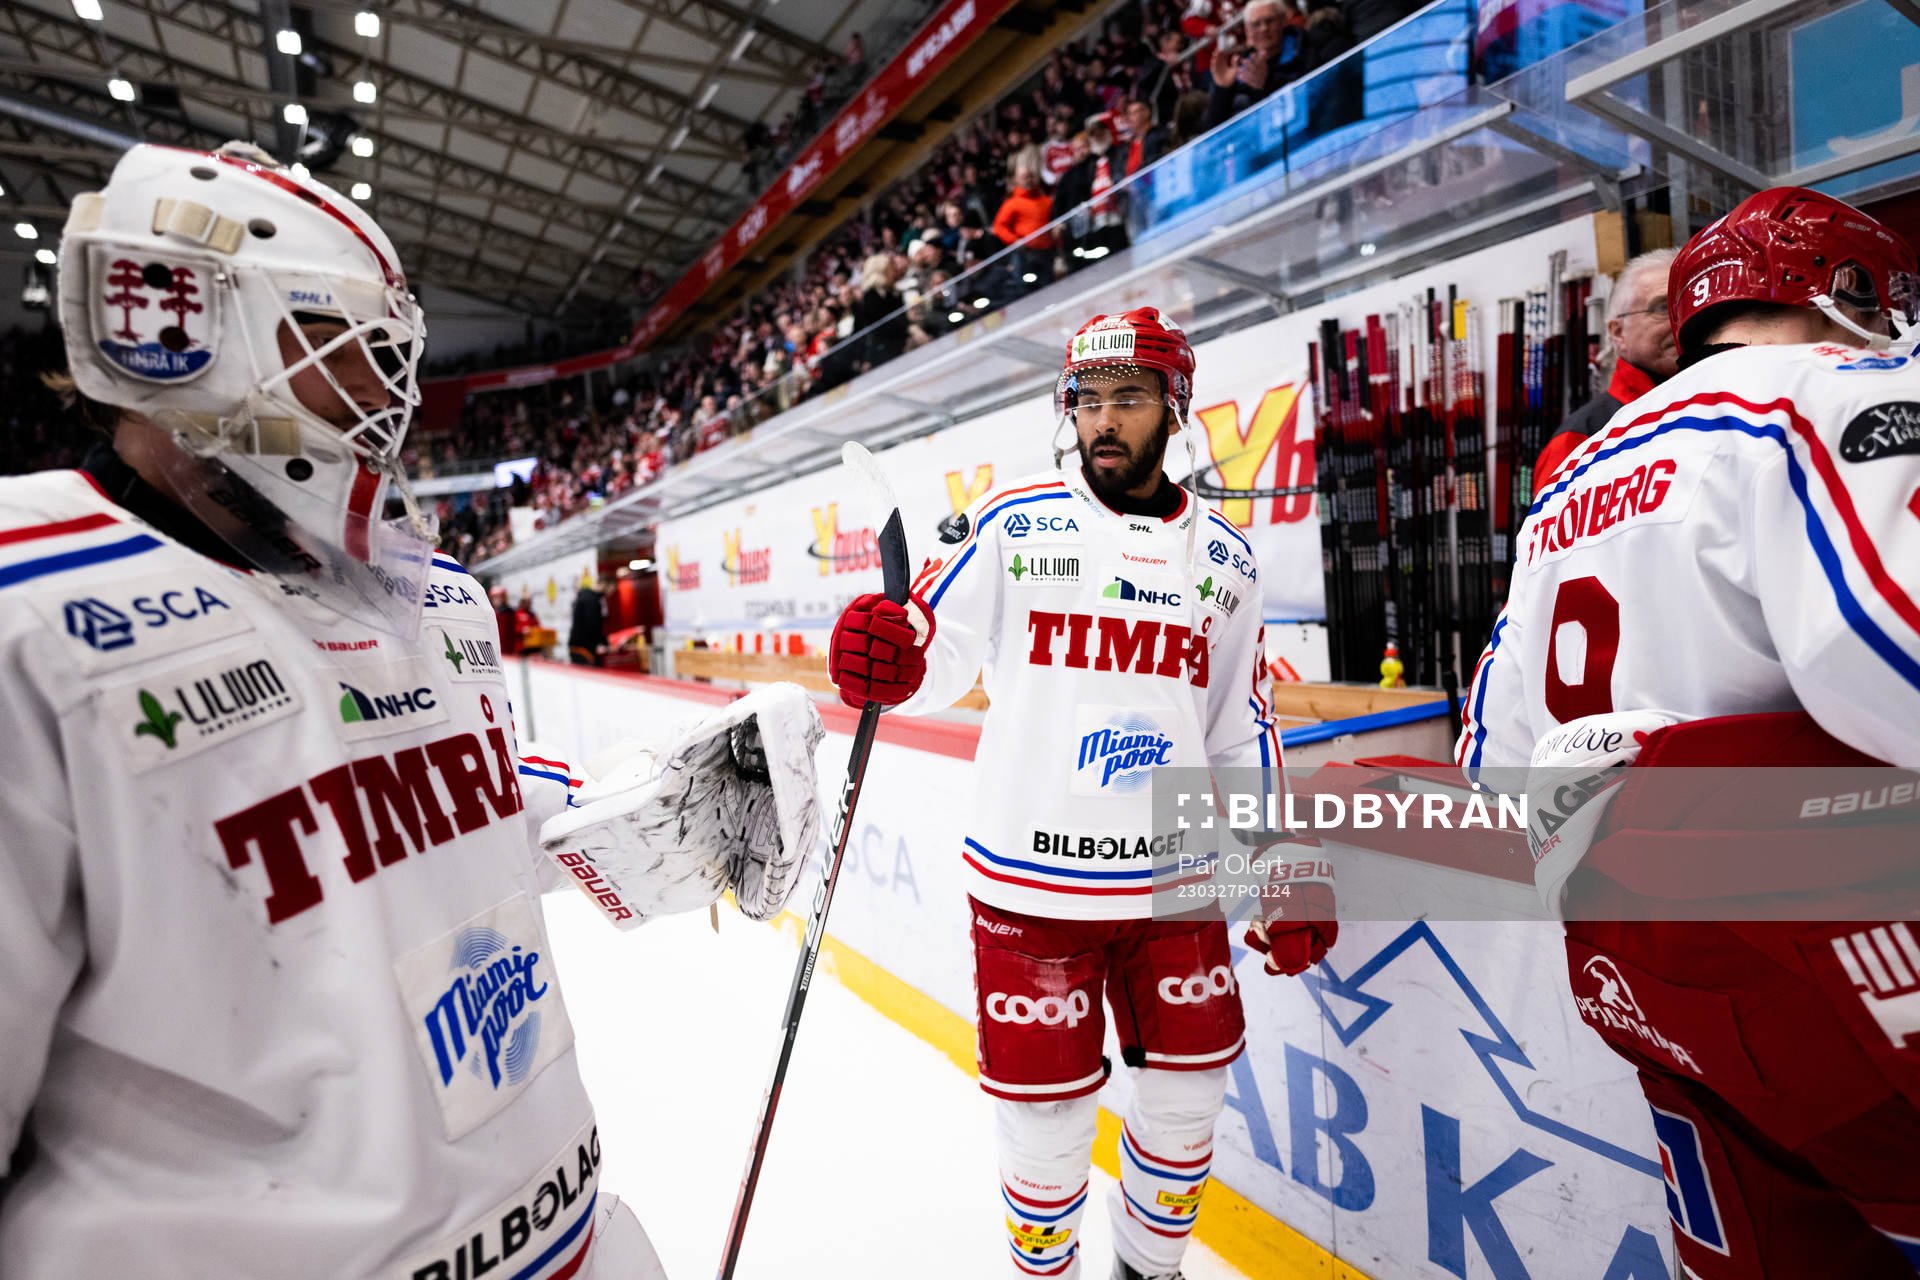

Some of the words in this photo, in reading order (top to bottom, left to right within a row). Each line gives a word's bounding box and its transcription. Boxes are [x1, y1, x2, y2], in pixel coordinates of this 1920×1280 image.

[1692, 278, 1711, 307] 9
[1092, 333, 1134, 351] LILIUM
[1036, 517, 1080, 532] SCA
[1128, 523, 1153, 534] SHL
[1030, 557, 1080, 577] LILIUM
[1130, 556, 1168, 566] BAUER
[1231, 554, 1258, 584] SCA
[132, 586, 231, 629] SCA
[430, 583, 478, 607] SCA
[1138, 590, 1182, 607] NHC
[326, 639, 379, 652] BAUER
[1027, 609, 1212, 689] TIMRÅ
[176, 659, 286, 727] LILIUM
[373, 687, 437, 720] NHC
[1077, 728, 1170, 772] Miami
[1100, 741, 1174, 788] pool
[213, 692, 525, 926] TIMRÅ
[1033, 830, 1185, 860] BILBOLAGET
[556, 852, 633, 921] BAUER
[424, 945, 524, 1088] Miami
[481, 951, 548, 1090] pool
[985, 988, 1091, 1030] coop
